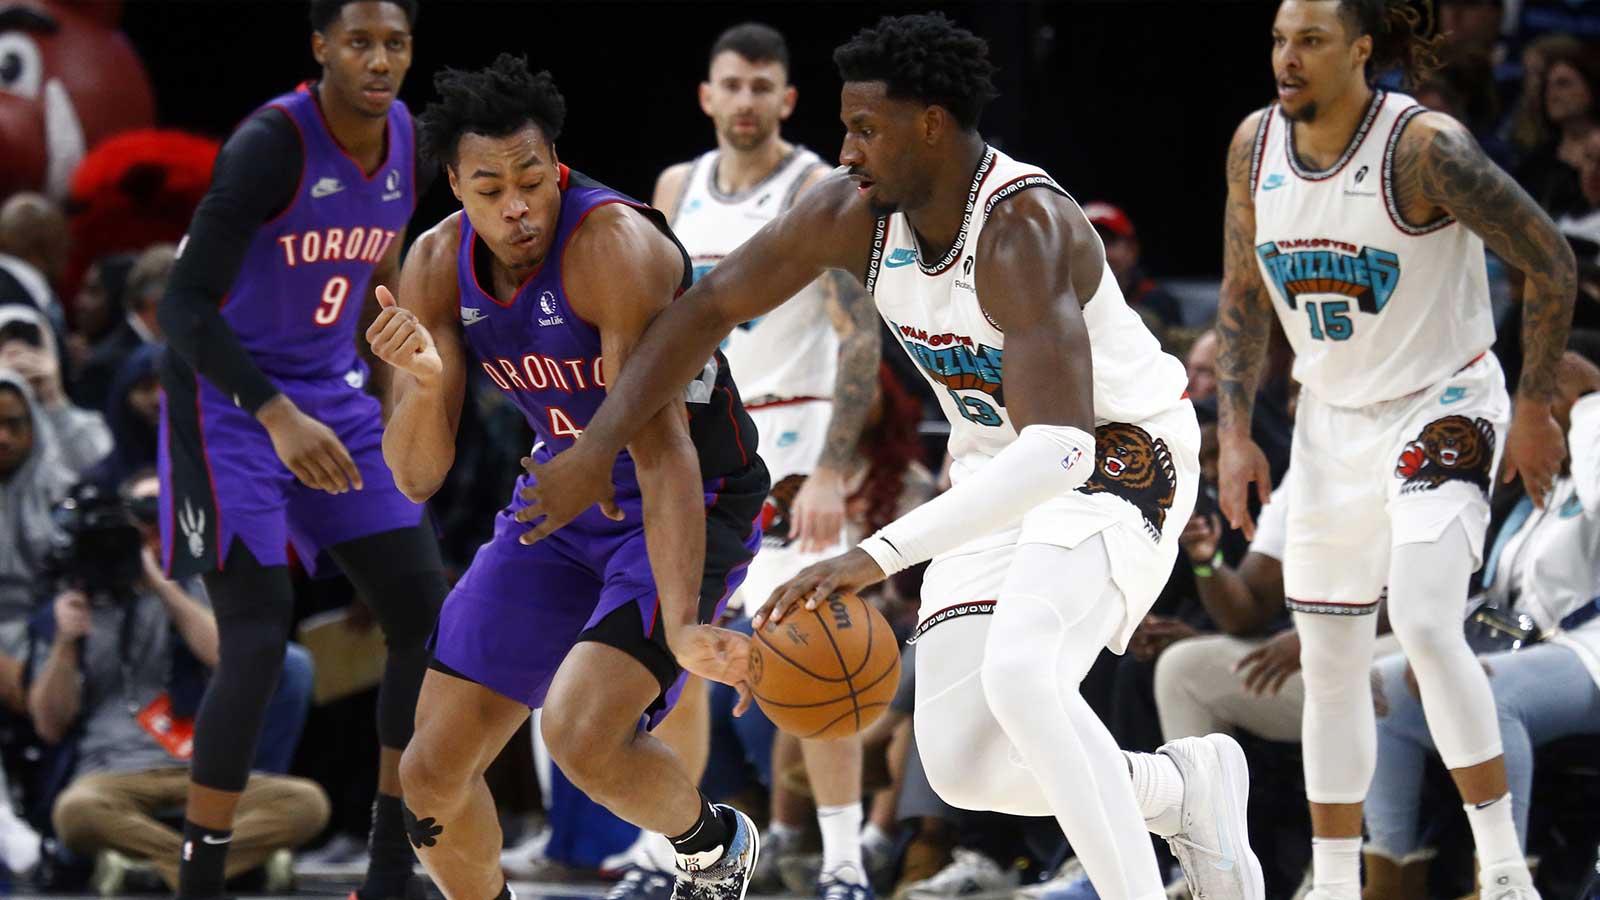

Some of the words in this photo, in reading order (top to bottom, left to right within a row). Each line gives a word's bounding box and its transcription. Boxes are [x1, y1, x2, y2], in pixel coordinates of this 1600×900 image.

[278, 226, 396, 267] TORONT
[1277, 238, 1357, 254] VANCOUVER
[1255, 241, 1401, 315] GRIZZLIES
[314, 275, 352, 328] 9
[538, 318, 551, 327] Sun
[551, 315, 564, 325] Life
[1305, 301, 1354, 342] 15
[481, 352, 606, 394] ORONT
[545, 405, 585, 441] 4
[946, 387, 1004, 427] 13
